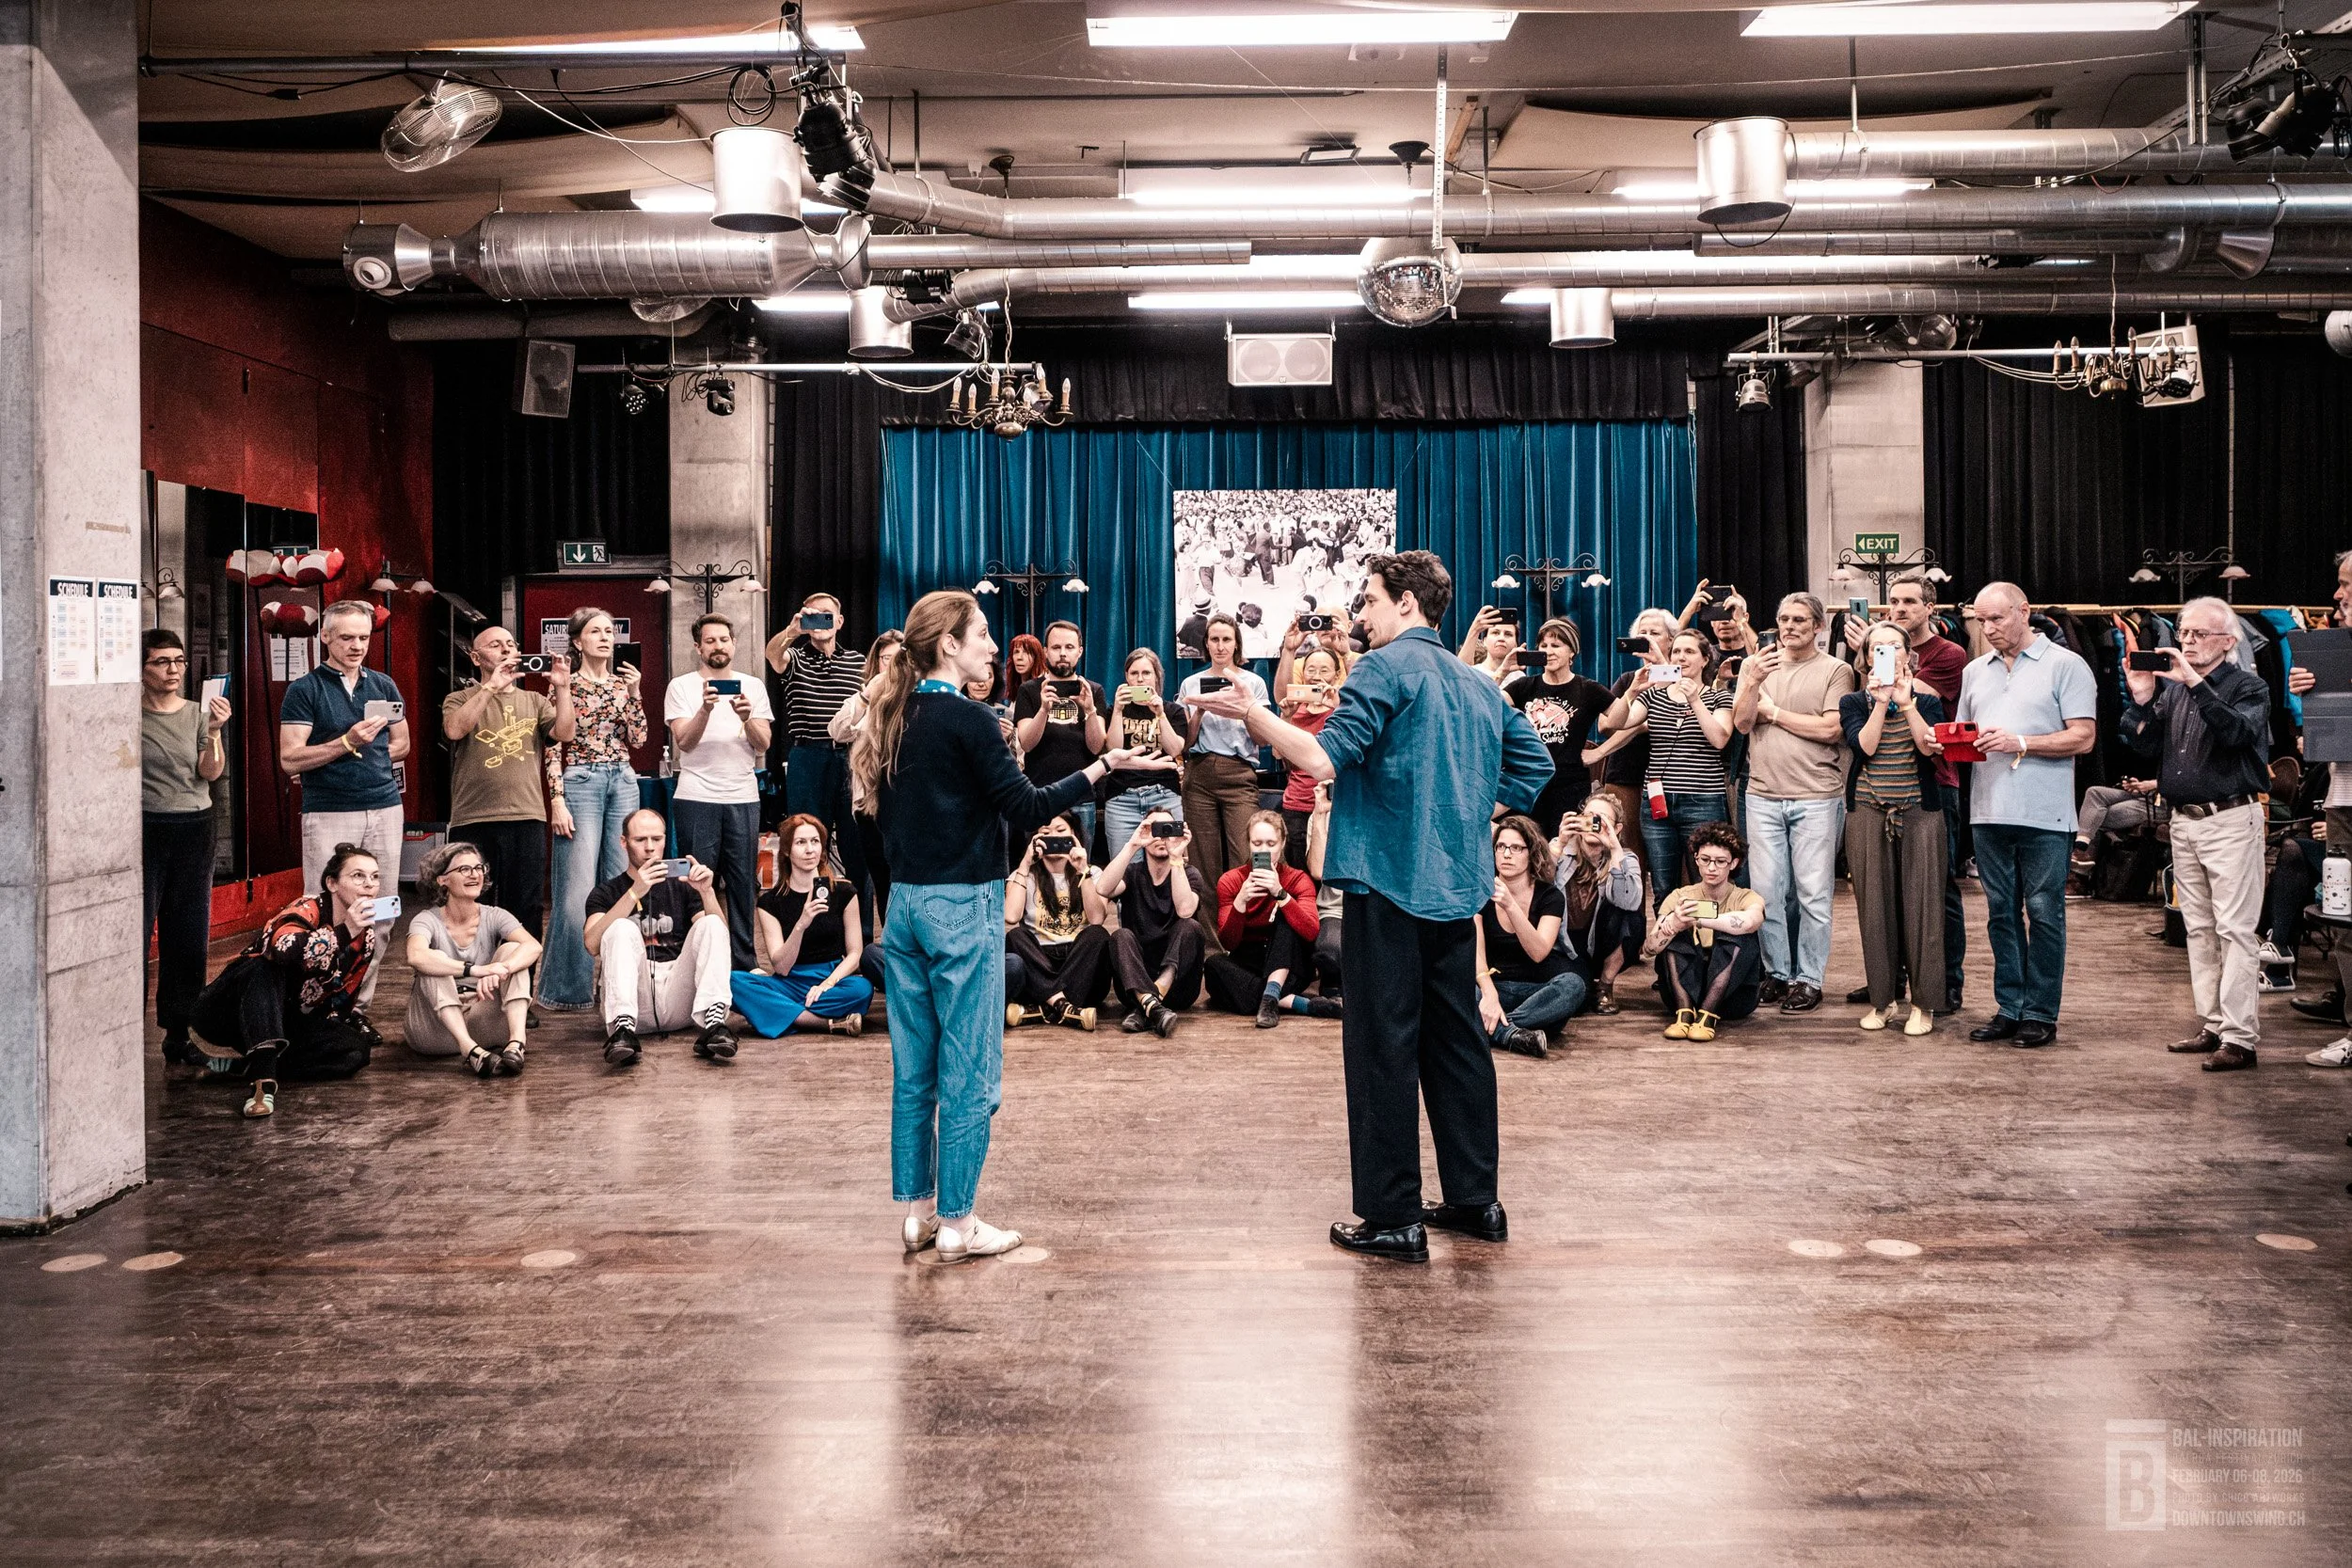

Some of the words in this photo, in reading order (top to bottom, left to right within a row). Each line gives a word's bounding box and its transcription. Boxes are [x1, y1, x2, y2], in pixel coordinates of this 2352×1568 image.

[1867, 538, 1897, 549] EXIT
[57, 582, 88, 597] SCHEDULE
[103, 584, 134, 599] SCHEDULE
[546, 624, 569, 635] SATUR
[1542, 733, 1565, 744] Swing
